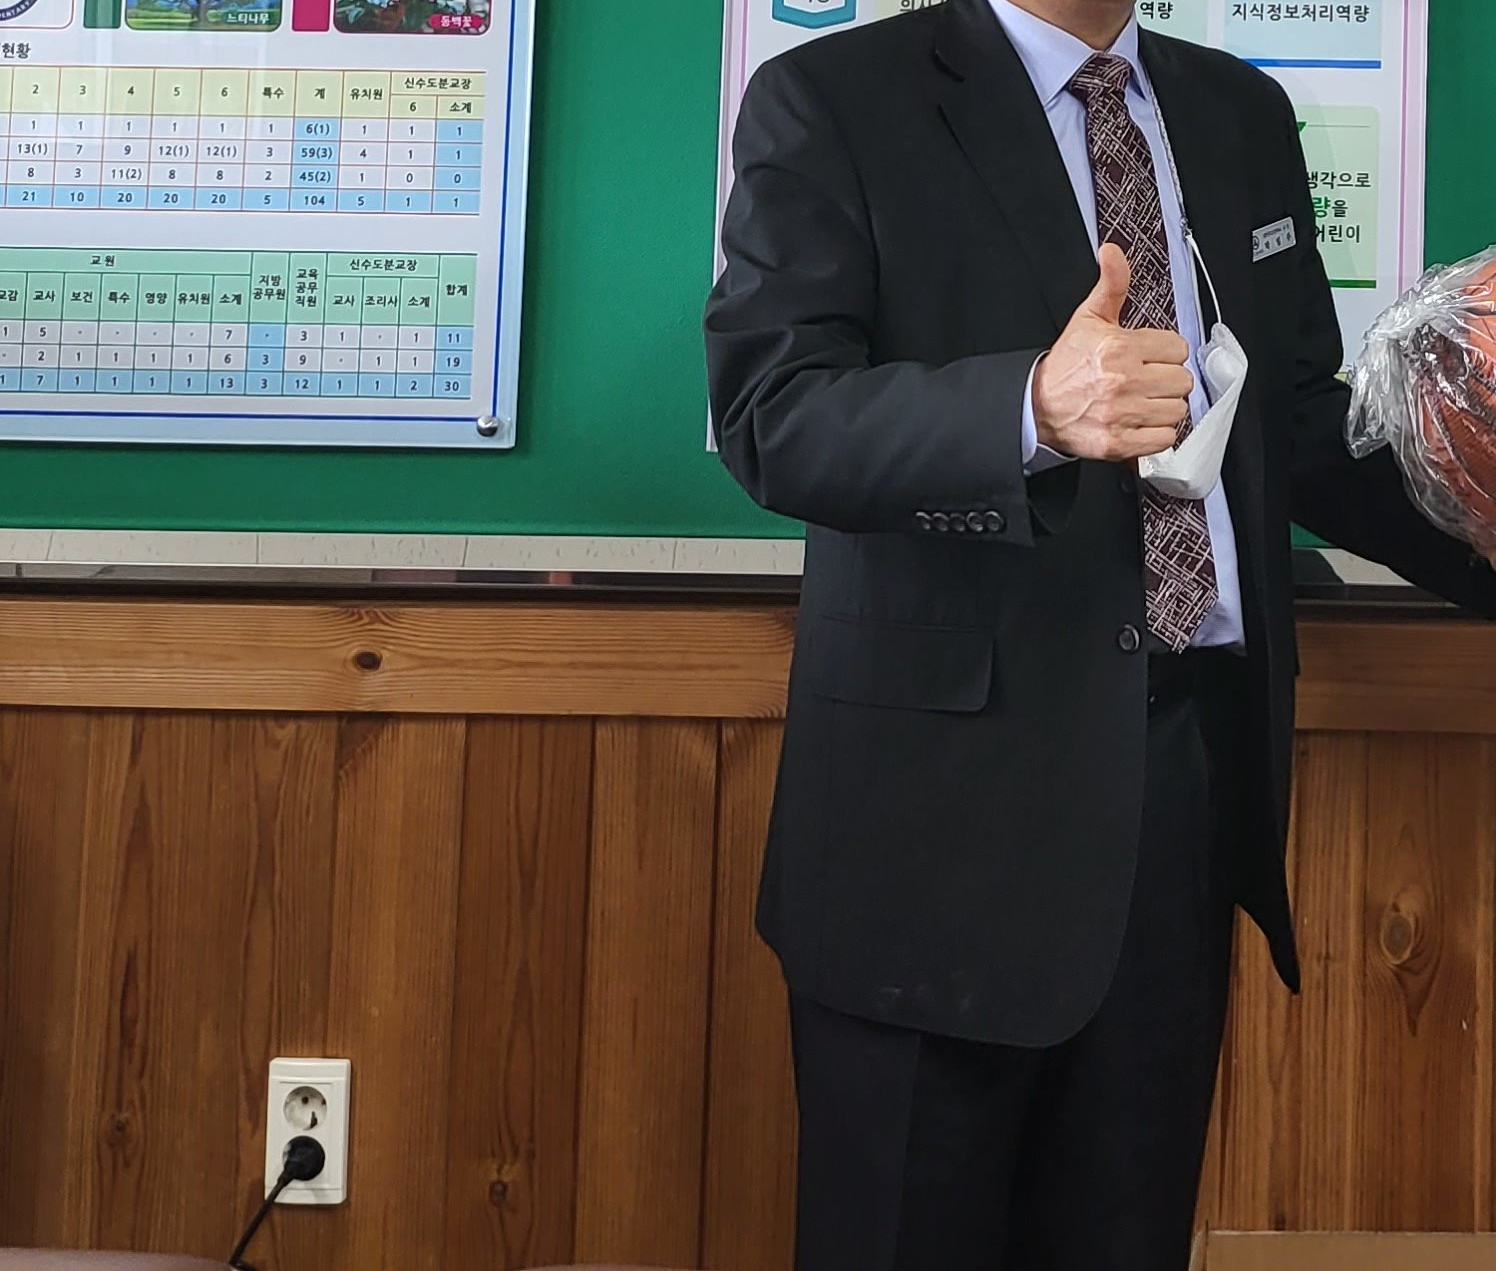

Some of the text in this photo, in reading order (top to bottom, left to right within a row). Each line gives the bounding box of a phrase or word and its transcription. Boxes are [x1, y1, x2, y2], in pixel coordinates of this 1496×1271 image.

[1232, 3, 1370, 24] 지식정보처리역량
[259, 274, 281, 287] 지방
[446, 284, 468, 297] 합계
[33, 290, 242, 306] 교사 유치원 소계
